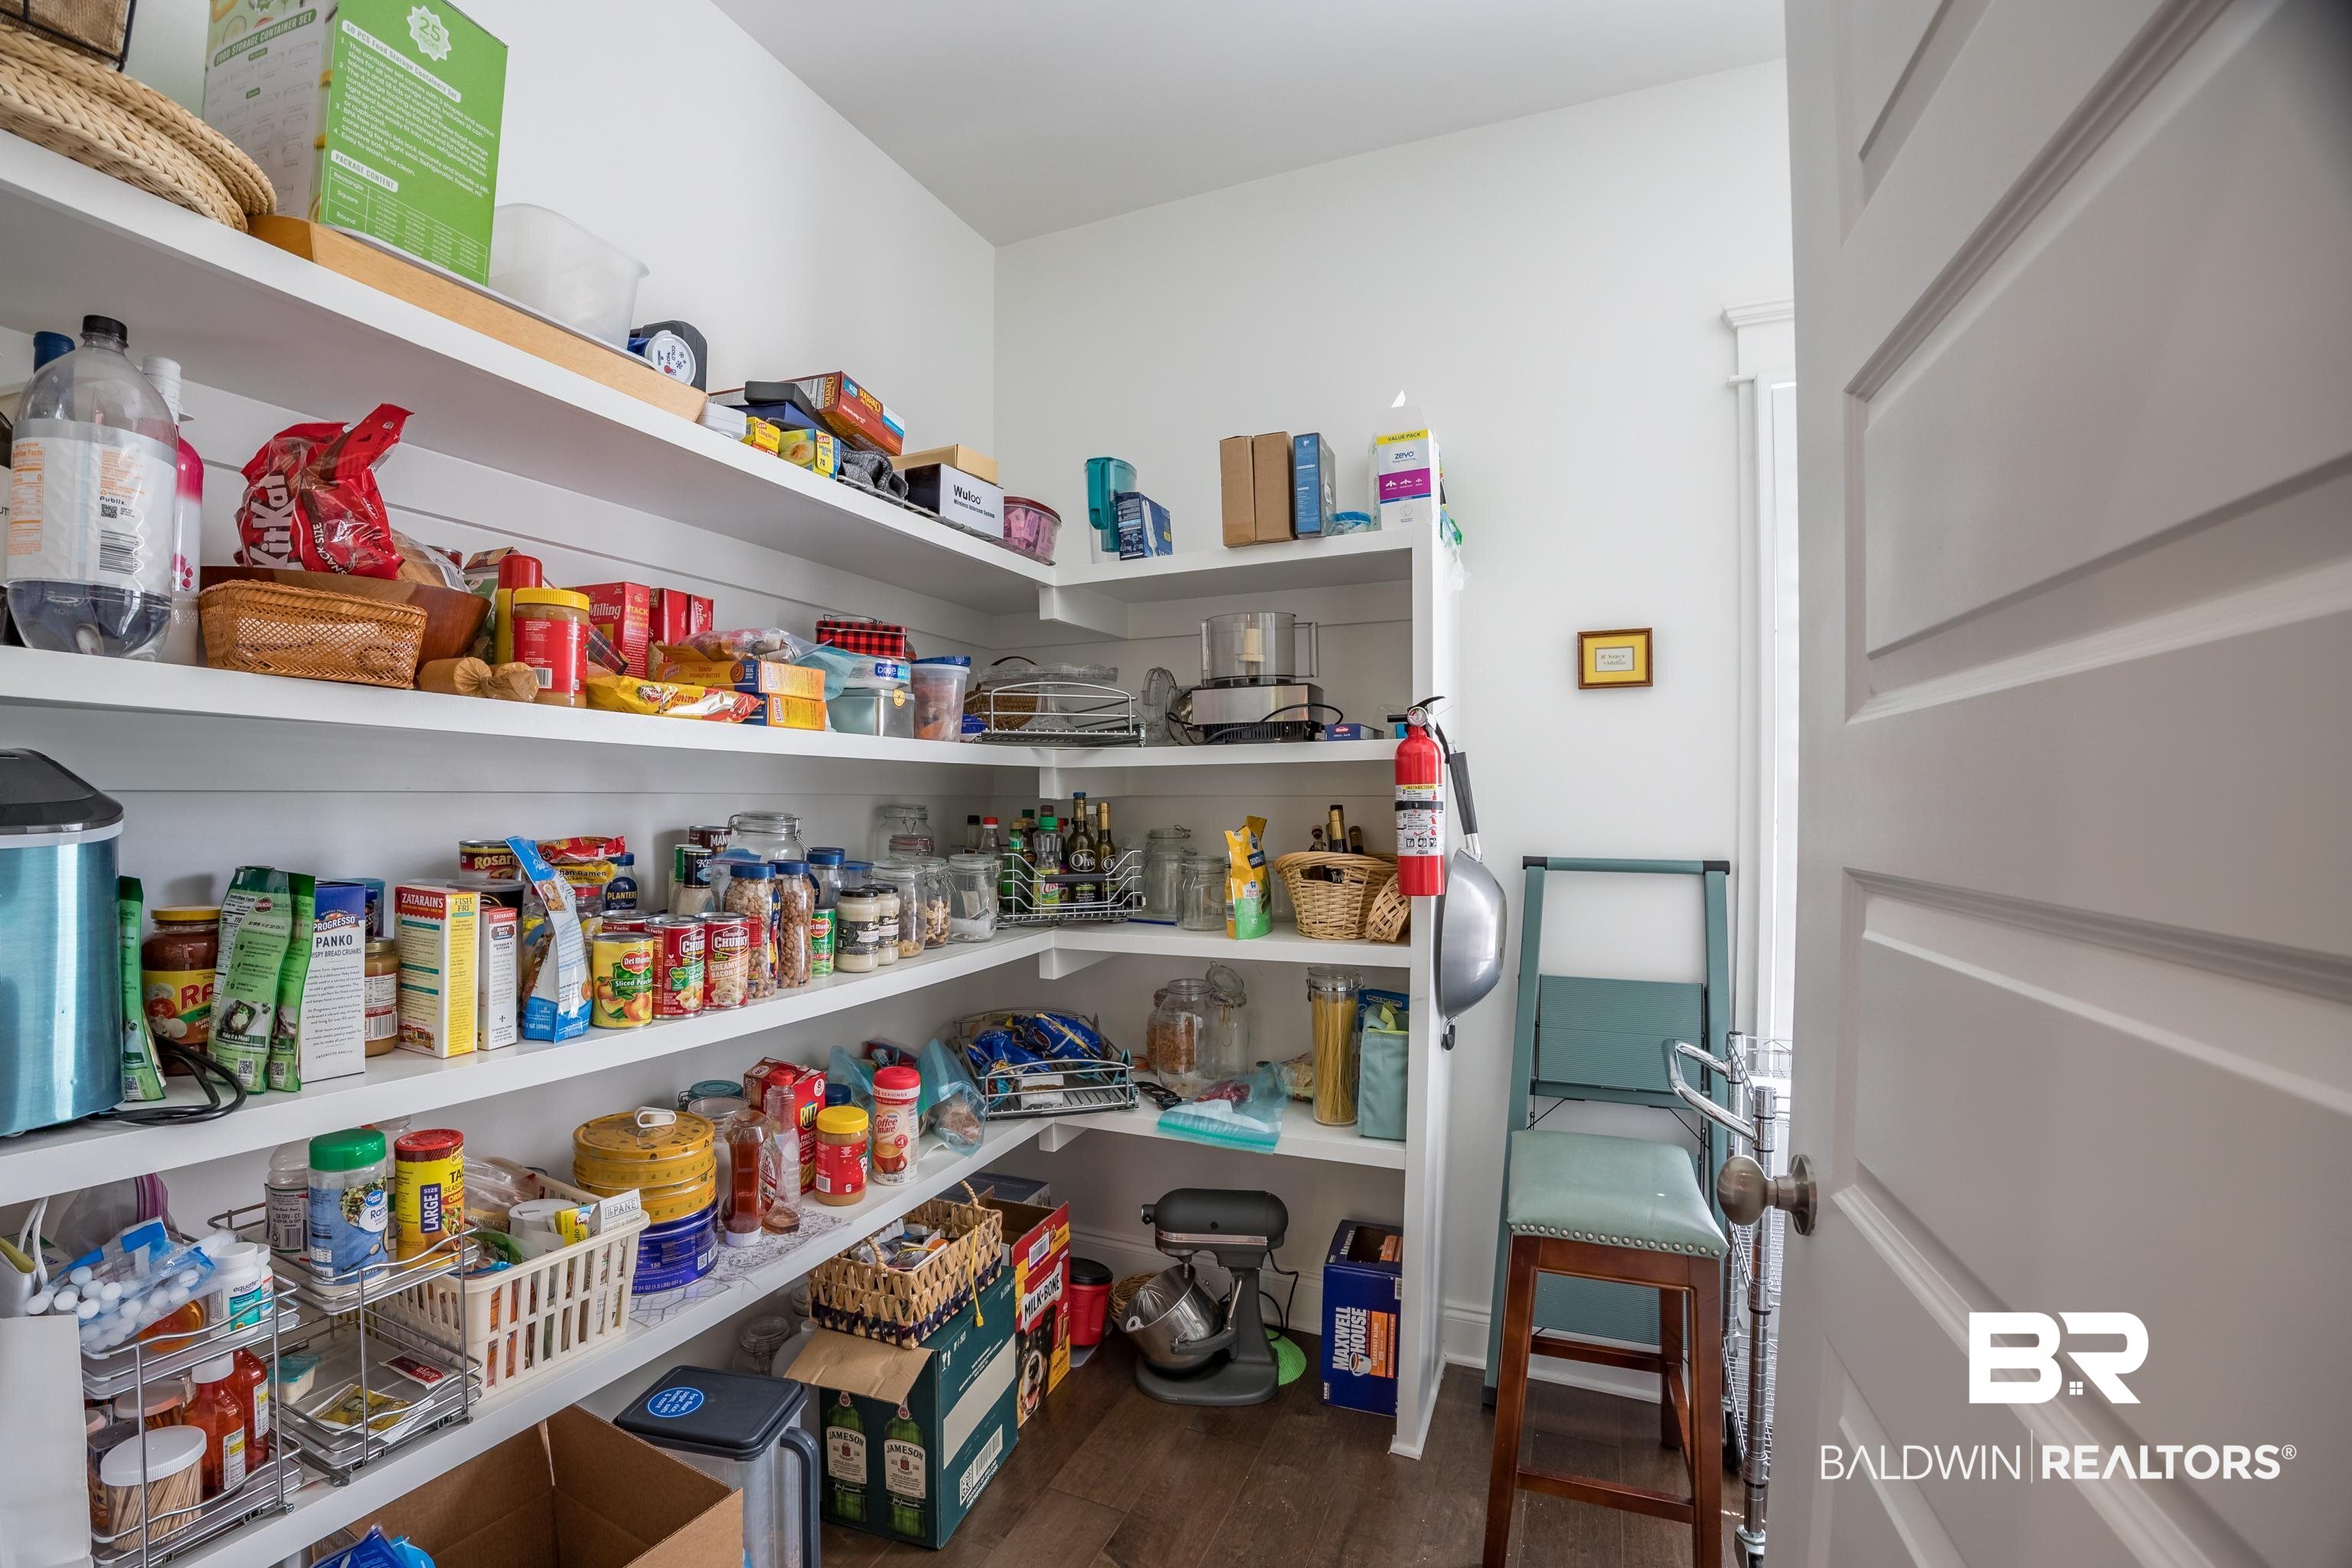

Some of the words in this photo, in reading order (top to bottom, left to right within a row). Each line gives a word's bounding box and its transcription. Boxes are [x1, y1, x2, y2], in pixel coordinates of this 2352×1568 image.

[231, 36, 258, 55] STORAGE
[260, 20, 297, 42] CONTAINER
[299, 11, 312, 25] SET
[419, 16, 441, 41] 25
[346, 24, 355, 34] 50
[358, 31, 371, 43] PCS
[372, 38, 388, 54] Food
[390, 49, 413, 70] Storage
[414, 63, 446, 92] Containers
[447, 87, 459, 100] Set
[348, 51, 364, 65] sizes
[365, 60, 374, 70] for
[384, 72, 397, 86] your
[398, 80, 423, 100] storage
[348, 58, 370, 76] tainers
[371, 71, 384, 84] and
[393, 84, 403, 96] lids
[404, 91, 411, 100] of
[412, 97, 430, 112] varied
[349, 42, 361, 54] The
[362, 51, 394, 74] container
[394, 70, 404, 80] set
[405, 77, 425, 93] comes
[426, 90, 439, 102] with
[444, 101, 463, 118] shapes
[464, 113, 475, 126] and
[475, 122, 495, 138] various
[341, 132, 358, 148] Easy
[358, 141, 365, 149] to
[366, 145, 383, 160] wash
[384, 155, 397, 167] and
[335, 153, 364, 174] PACKAGE
[366, 167, 395, 190] CONTENT
[334, 171, 364, 192] Rectangle
[337, 190, 359, 205] Square
[336, 211, 357, 226] Round
[818, 434, 830, 443] GLAD
[1387, 433, 1405, 442] VALUE
[819, 458, 826, 466] 70
[1394, 450, 1414, 459] zevo
[100, 495, 125, 505] Publix
[954, 485, 982, 505] Wuloo
[953, 499, 969, 510] Wireless
[969, 504, 983, 515] Intercom
[983, 509, 995, 519] System
[312, 522, 325, 544] SIZE
[626, 606, 648, 616] STACK
[402, 893, 443, 908] ZATARAIN'S
[607, 891, 638, 900] PLANTERS
[313, 916, 355, 932] PROGRESSO
[316, 934, 353, 948] PANKO
[714, 936, 748, 948] CHUNKY
[635, 956, 652, 965] Monte
[710, 961, 737, 972] CREAMY
[711, 970, 733, 979] BACON
[799, 1102, 818, 1128] RITZ
[874, 1115, 897, 1129] Coffee
[423, 1194, 439, 1232] LARGE
[613, 1200, 637, 1214] PANE
[233, 1280, 257, 1293] equate
[1332, 1307, 1351, 1369] MAXWELL
[1351, 1308, 1367, 1354] HOUSE
[655, 1397, 668, 1409] more
[828, 1431, 864, 1447] JAMESON
[887, 1444, 924, 1461] JAMESON
